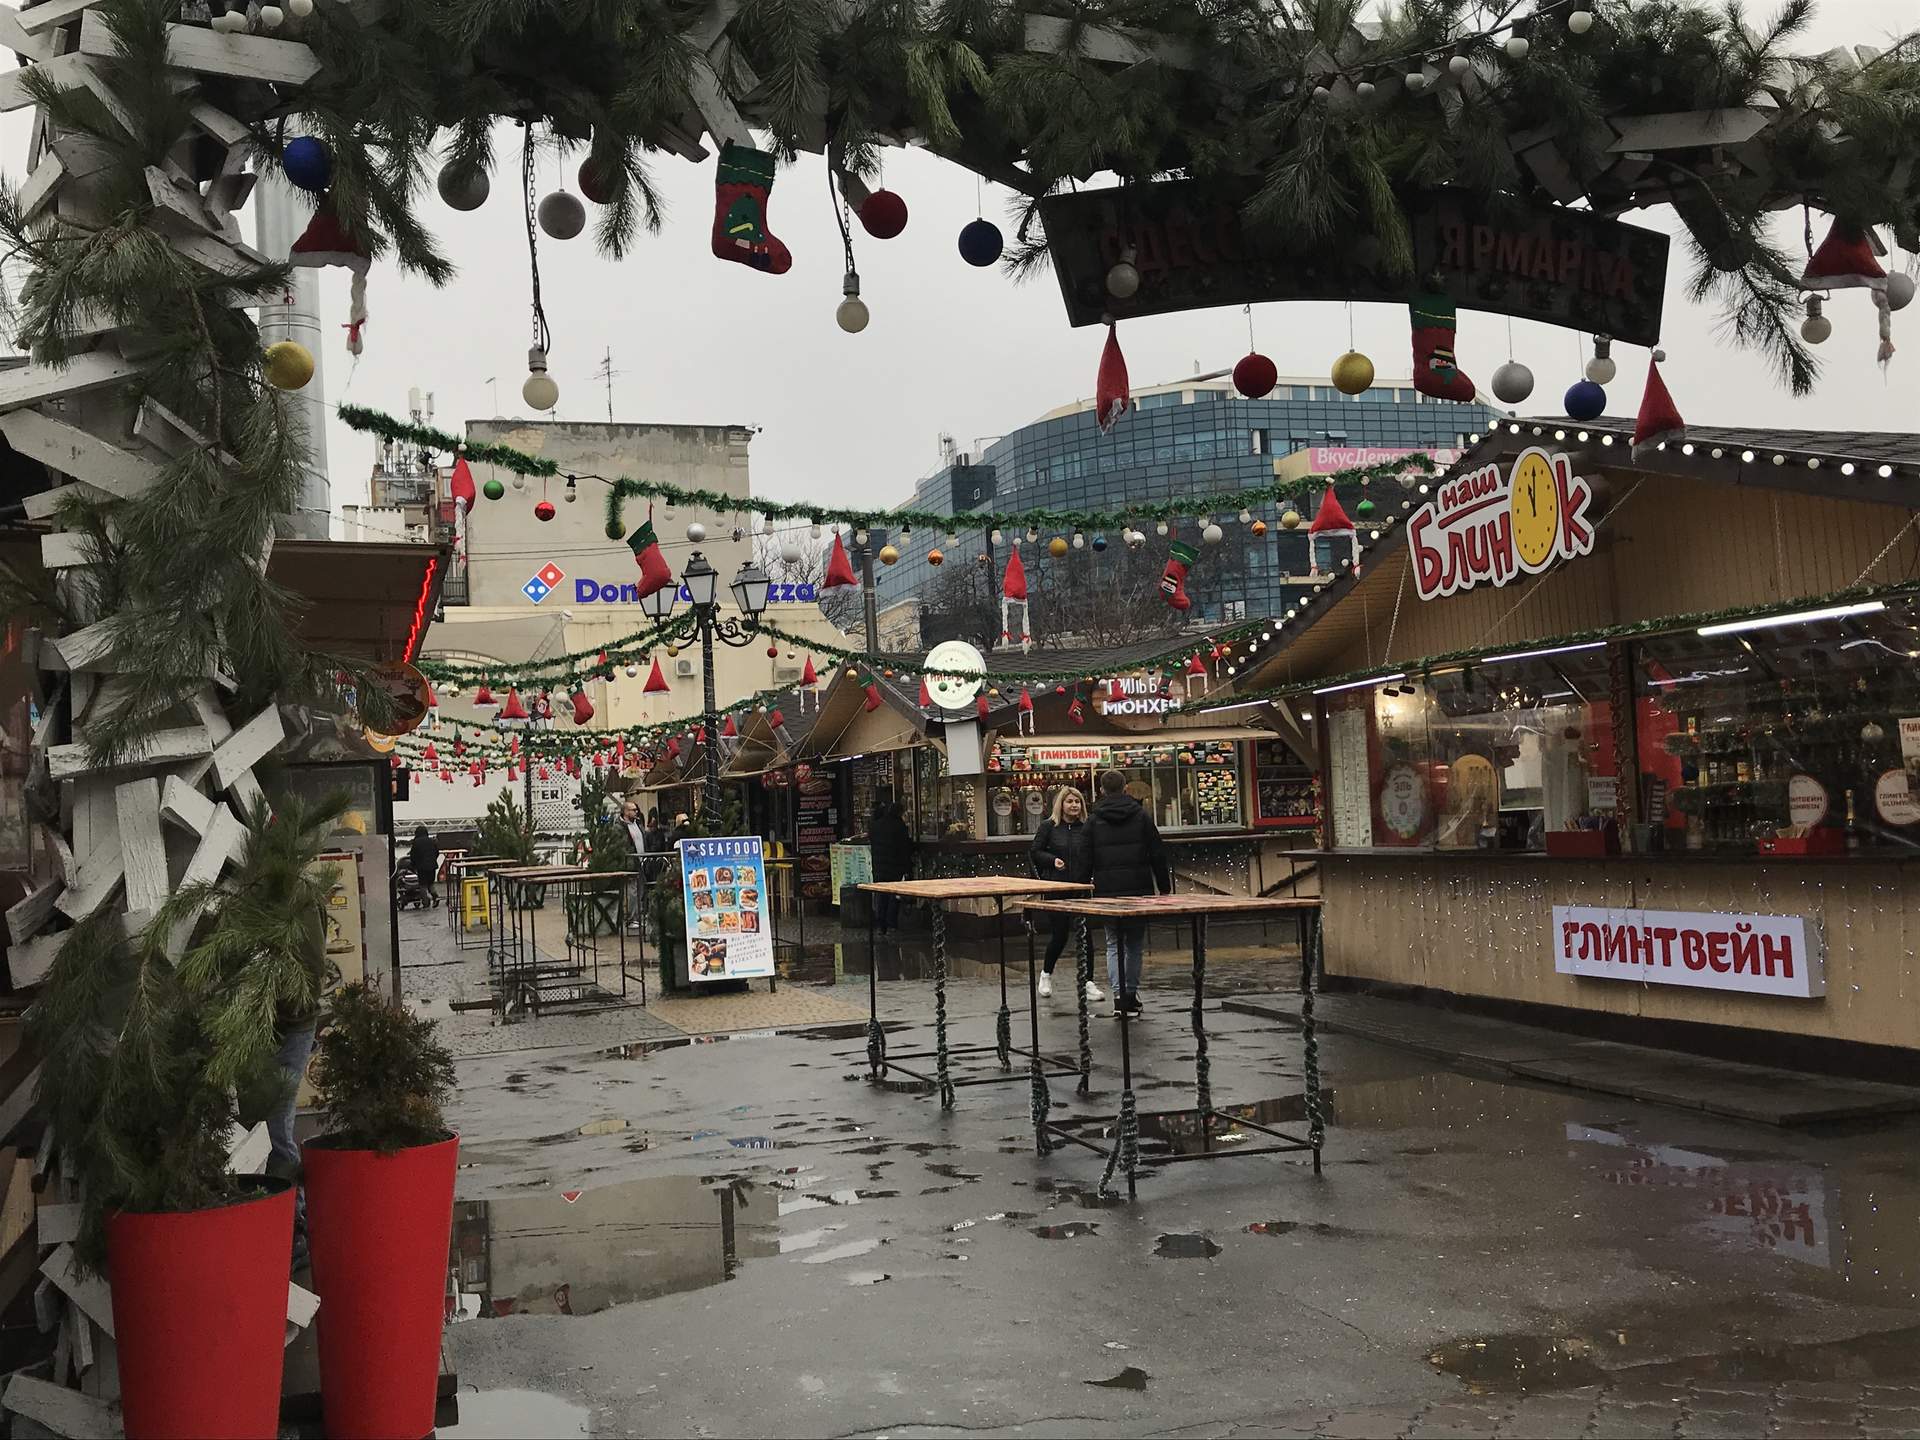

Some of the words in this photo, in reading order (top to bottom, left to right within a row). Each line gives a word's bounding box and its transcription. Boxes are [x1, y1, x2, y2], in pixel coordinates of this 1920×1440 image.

[1441, 222, 1636, 299] ЯРМАРКА
[1442, 469, 1498, 512] наш
[1102, 698, 1181, 716] МЮНХЕН
[1040, 748, 1099, 760] ГЛИНТВЕЙН
[699, 841, 759, 857] SEAFOOD
[1562, 921, 1794, 979] ГЛИНТВЕЙН
